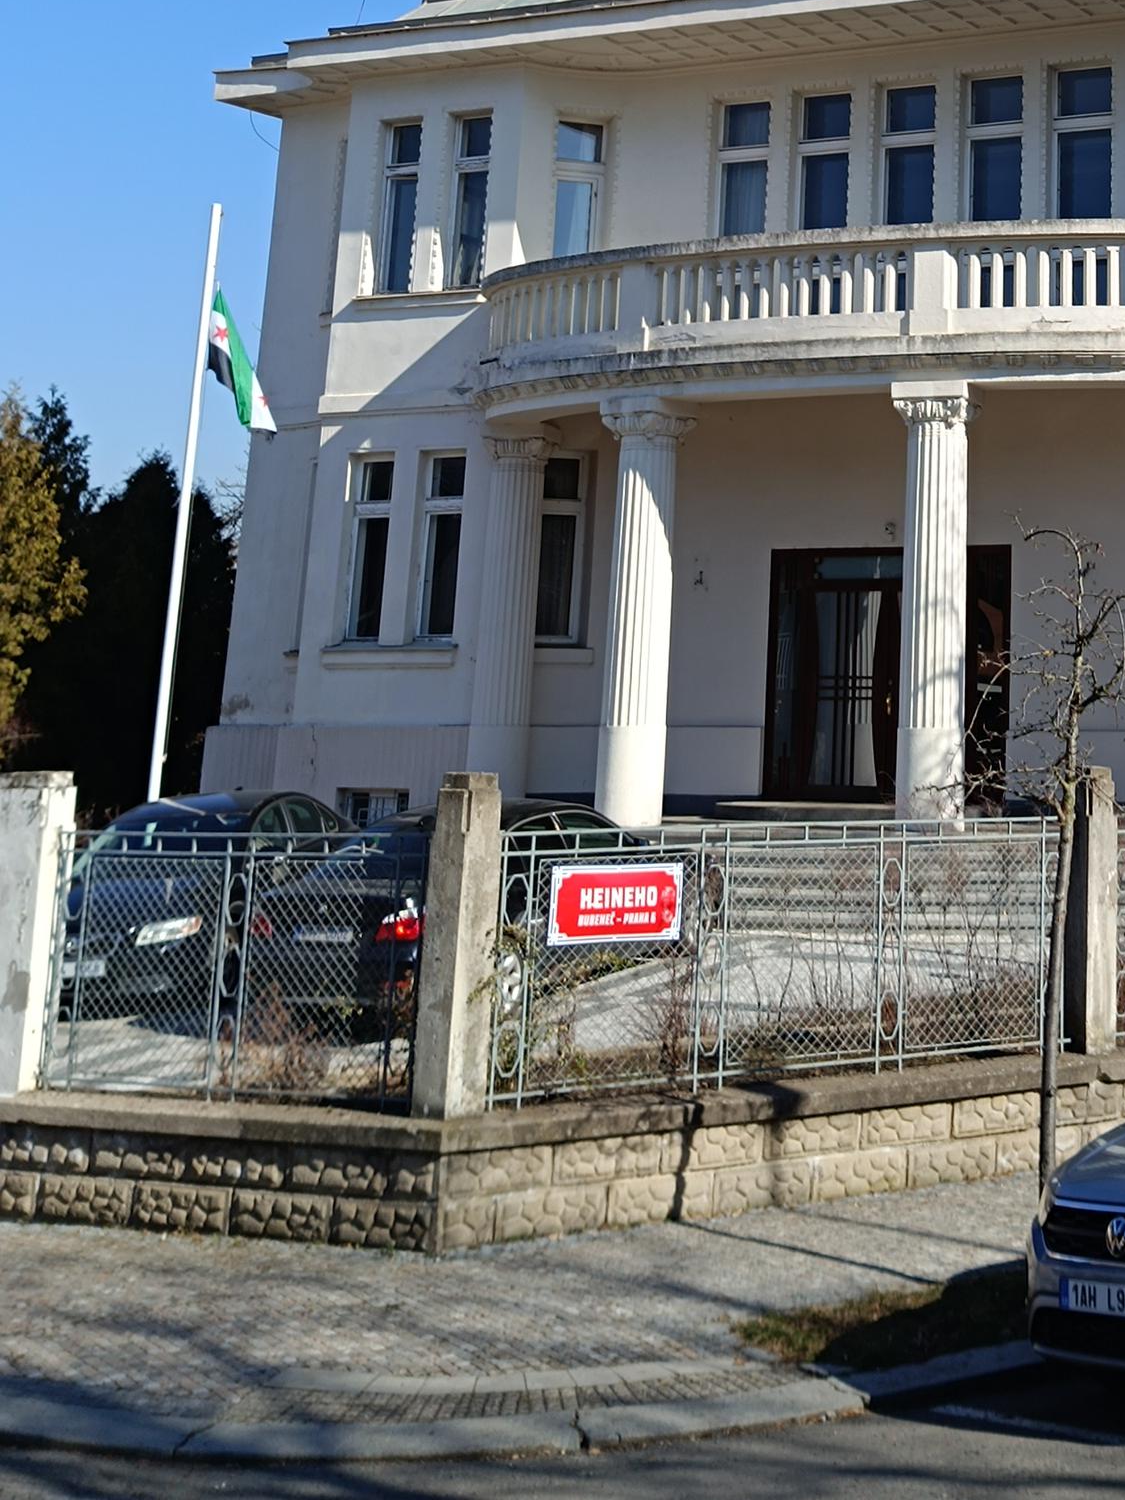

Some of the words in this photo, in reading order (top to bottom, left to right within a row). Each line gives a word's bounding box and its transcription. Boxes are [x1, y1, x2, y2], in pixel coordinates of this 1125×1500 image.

[580, 886, 658, 909] HEINEHO
[623, 912, 649, 925] PRAHA
[650, 911, 657, 925] 6
[1072, 1283, 1097, 1309] 1AH
